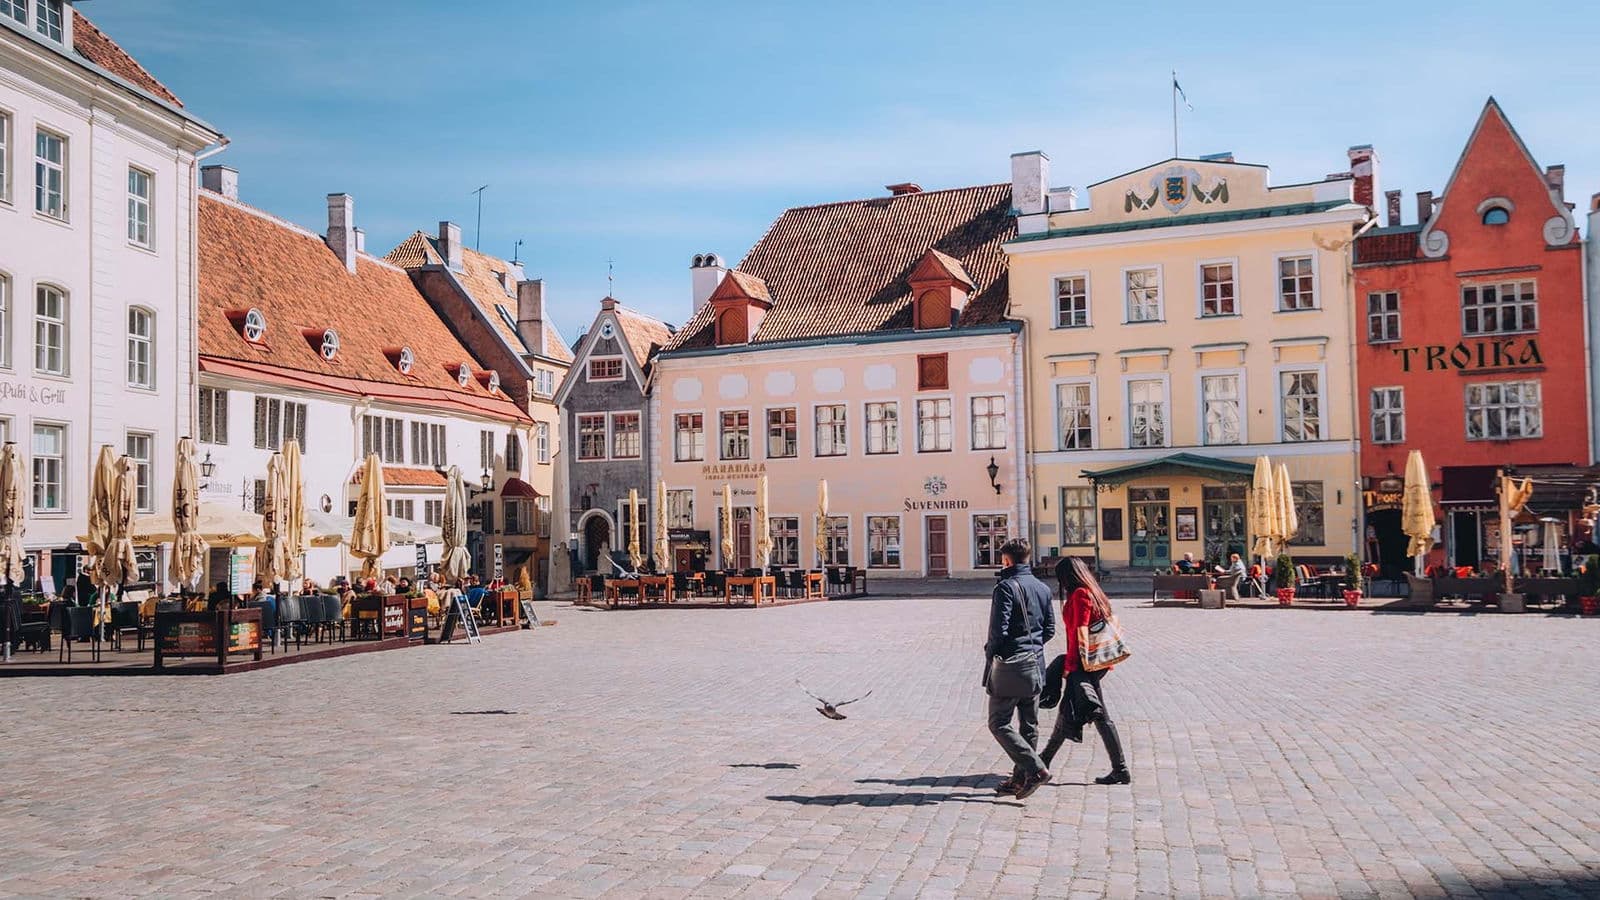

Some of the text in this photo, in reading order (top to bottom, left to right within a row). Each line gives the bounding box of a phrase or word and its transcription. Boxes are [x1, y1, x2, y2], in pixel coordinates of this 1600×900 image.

[1392, 339, 1544, 372] TROIKA
[0, 382, 66, 405] Pubi & Grill
[702, 463, 766, 474] MAHARAJA
